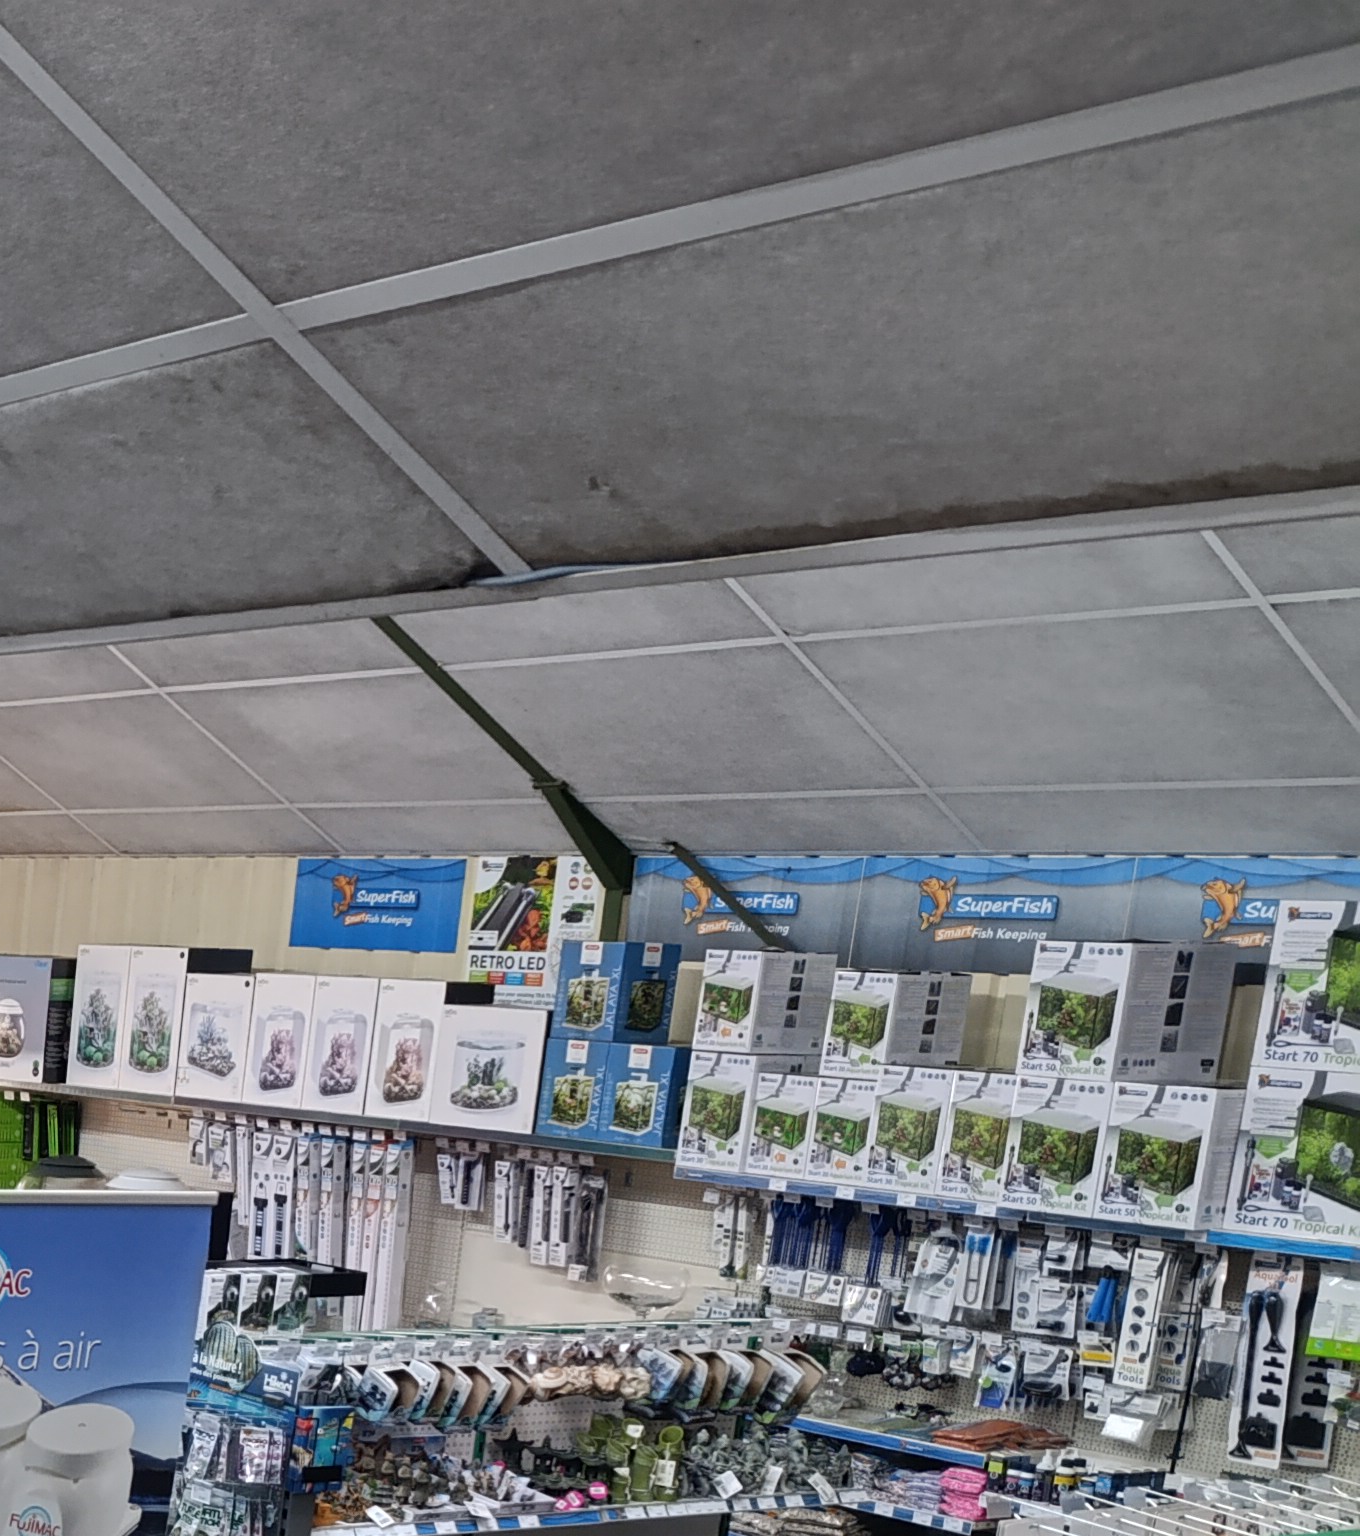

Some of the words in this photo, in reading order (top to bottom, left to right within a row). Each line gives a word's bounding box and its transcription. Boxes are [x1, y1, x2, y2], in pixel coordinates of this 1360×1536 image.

[357, 890, 416, 904] SuperFish
[956, 897, 1056, 916] SuperFish
[381, 914, 413, 927] Keeping
[699, 920, 727, 934] Smart
[727, 921, 745, 932] Fish
[937, 926, 971, 940] Smart
[971, 926, 994, 939] Fish
[996, 927, 1047, 942] Keeping
[470, 955, 515, 970] RETRO
[518, 957, 546, 970] LED
[605, 979, 619, 1032] JALAYA
[613, 965, 622, 978] XL
[1264, 1049, 1299, 1062] Start
[1302, 1051, 1318, 1063] 70
[1021, 1062, 1041, 1071] Start
[1043, 1063, 1056, 1072] 50
[660, 1070, 671, 1085] XL
[588, 1081, 602, 1130] JALAYA
[596, 1065, 606, 1079] XL
[653, 1086, 668, 1136] JALAYA
[867, 1177, 883, 1185] Start
[1002, 1194, 1022, 1204] Start
[1024, 1196, 1037, 1206] 50
[1098, 1206, 1119, 1215] Start
[1120, 1208, 1136, 1218] 50
[1234, 1213, 1269, 1227] Start
[1272, 1216, 1288, 1229] 70
[1293, 1217, 1344, 1237] Tropical
[18, 1329, 40, 1371] à
[53, 1331, 102, 1369] air
[199, 1352, 208, 1365] la
[208, 1355, 237, 1373] Nature
[1118, 1363, 1145, 1376] Aqua
[1117, 1371, 1144, 1385] Tools
